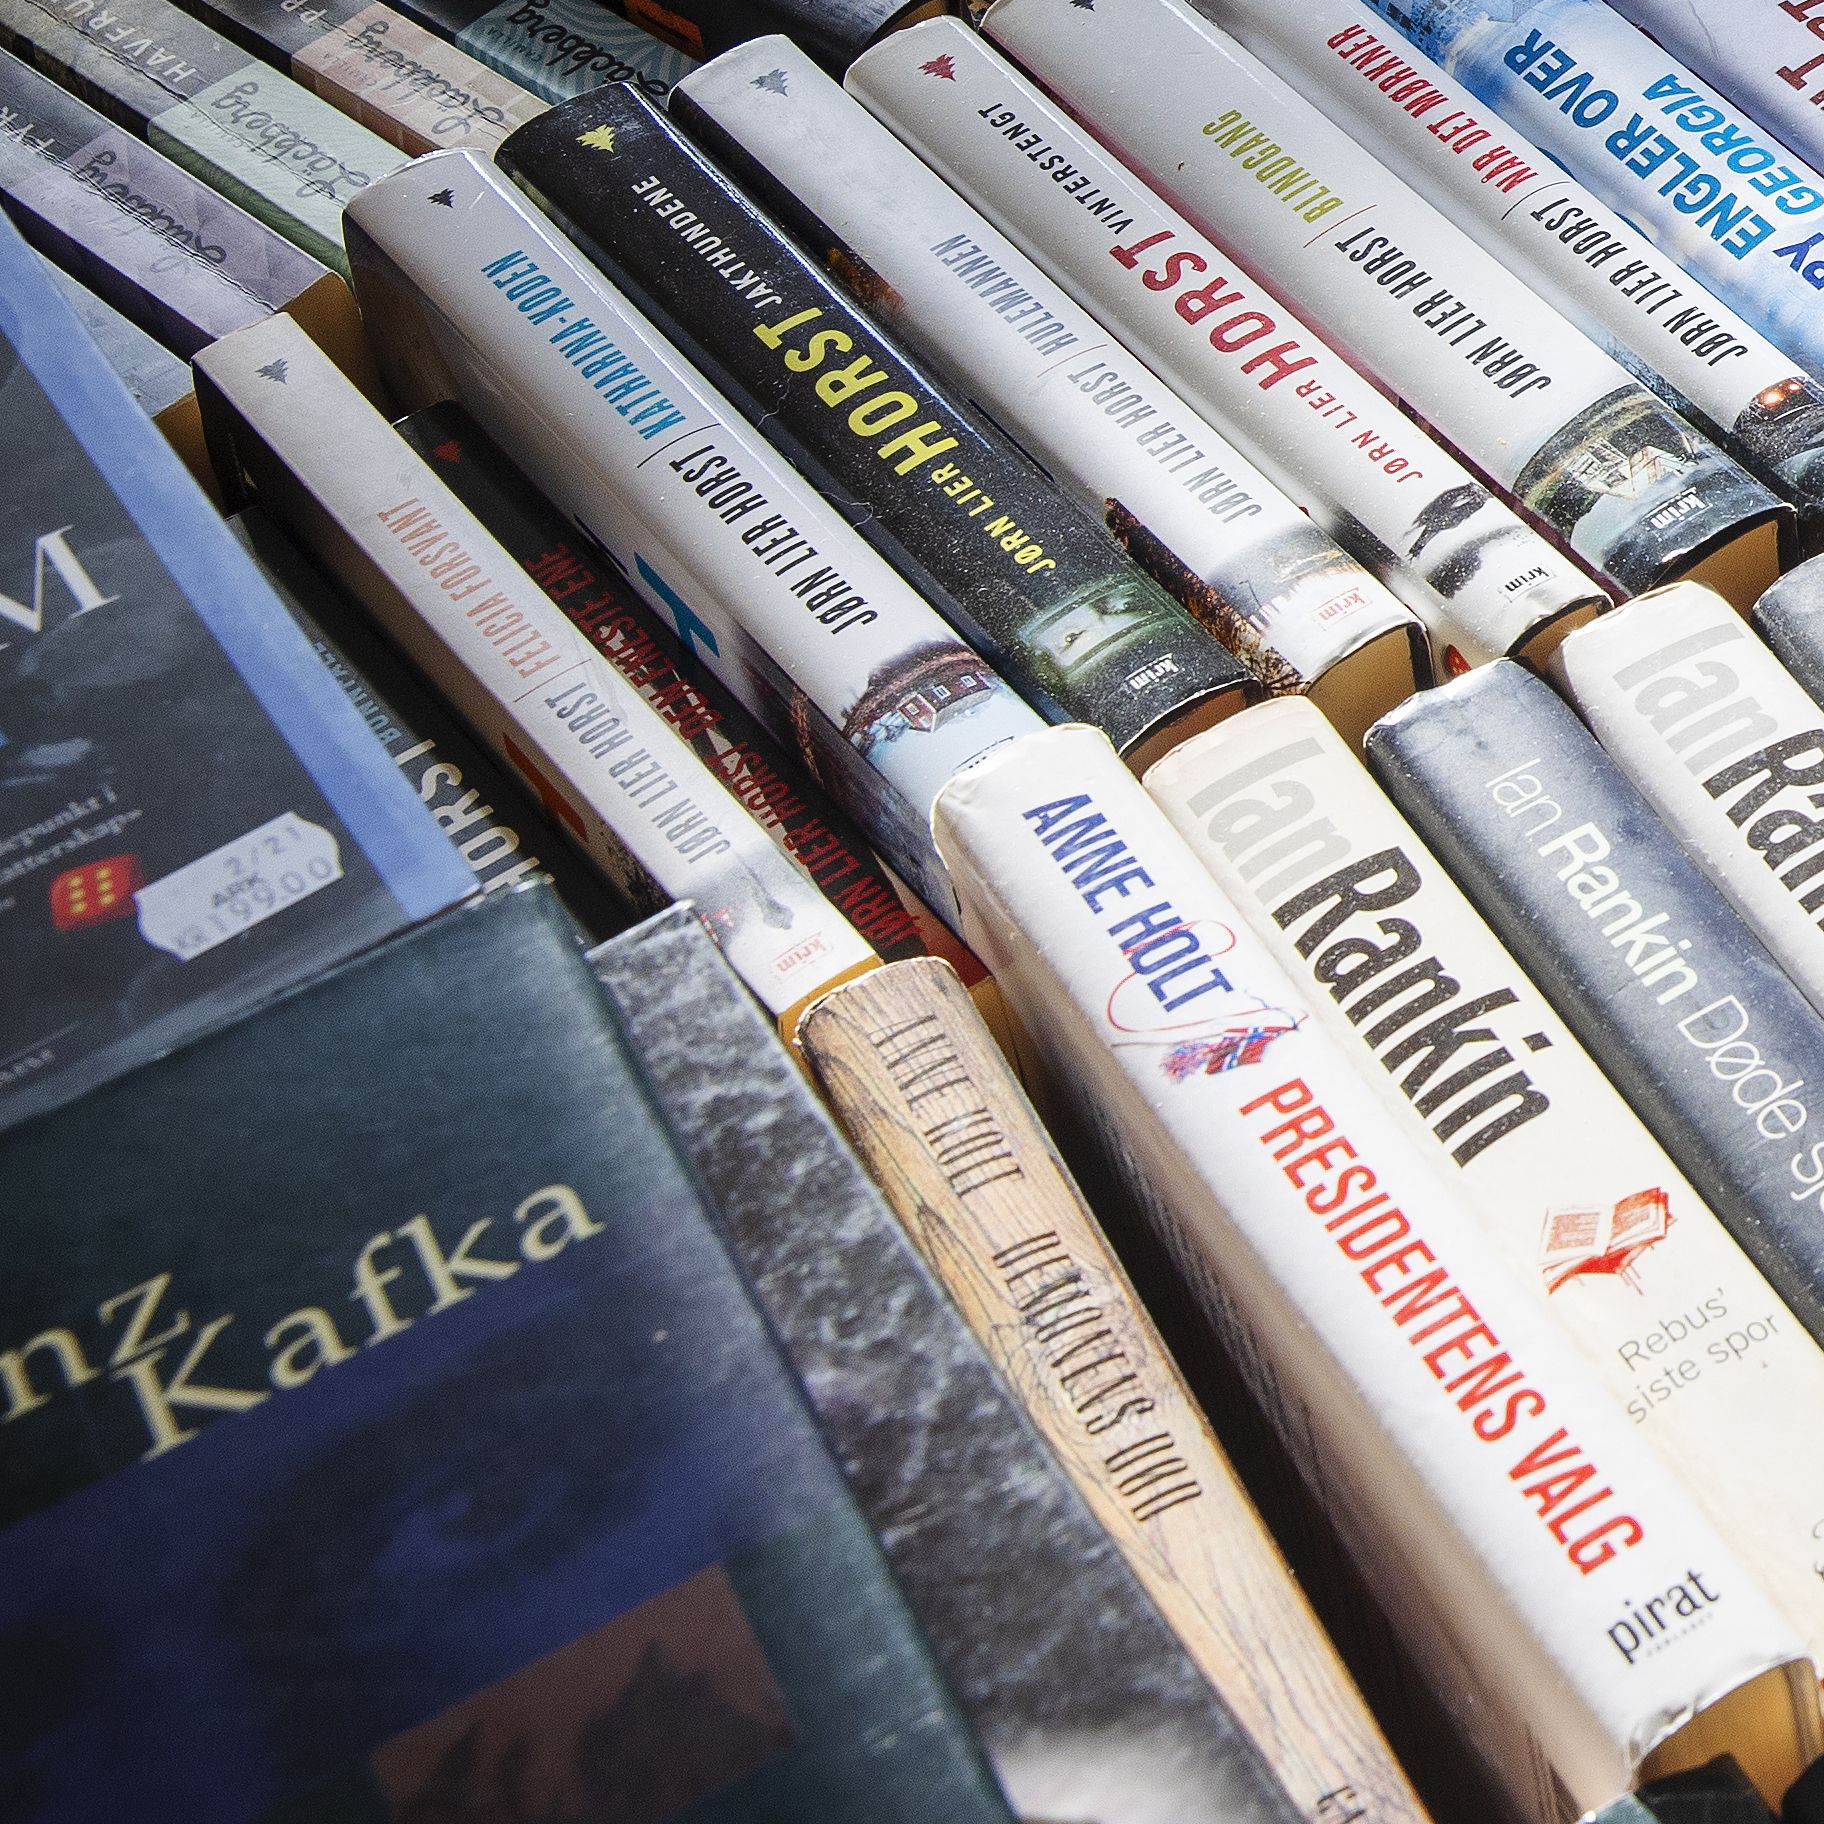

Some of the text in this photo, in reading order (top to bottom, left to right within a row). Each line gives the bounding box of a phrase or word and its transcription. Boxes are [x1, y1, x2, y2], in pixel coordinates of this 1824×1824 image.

[1326, 22, 1448, 121] MØRKNER
[629, 174, 784, 307] JAKTHUNDENE
[977, 102, 1132, 235] VINTERSTENGT
[1201, 107, 1345, 226] BLINDGANG
[1604, 114, 1788, 268] ENGLER
[480, 250, 688, 443] KATHARINA-KODEN
[929, 231, 1081, 360] HULEMANNEN
[1108, 231, 1321, 394] HORST
[752, 306, 949, 477] HORST
[1021, 792, 1235, 1017] ANNE HOLT
[139, 1183, 604, 1462] Kafka
[1237, 1075, 1646, 1577] PRESIDENTENS VALG
[1606, 1566, 1721, 1666] pirat
